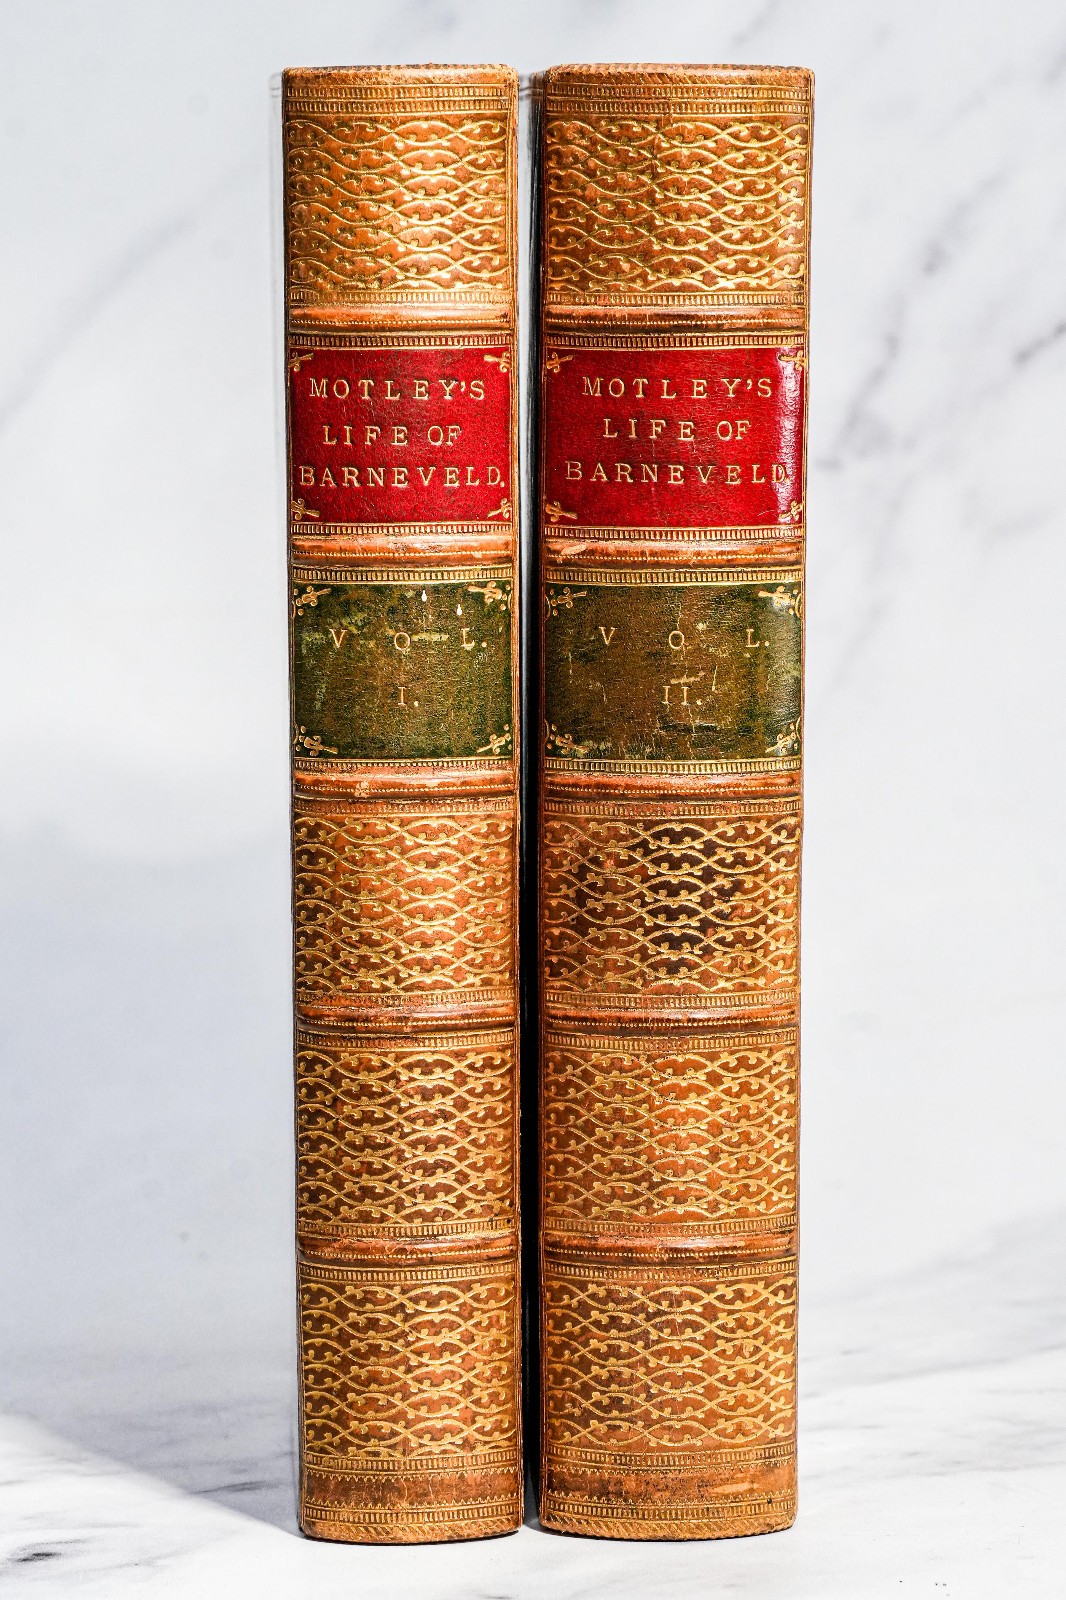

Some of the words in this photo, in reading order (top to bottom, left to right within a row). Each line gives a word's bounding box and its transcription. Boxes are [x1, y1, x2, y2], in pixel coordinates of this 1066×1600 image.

[309, 378, 485, 400] MOTLEY'S
[582, 376, 773, 398] MOTLEY'S
[322, 425, 409, 446] LIFE
[427, 425, 462, 446] OF
[603, 418, 695, 440] LIFE
[716, 420, 751, 440] OF
[299, 466, 505, 488] BARNEVELD.
[329, 627, 487, 650] VOL.
[599, 626, 770, 650] VOL.
[397, 686, 419, 706] I.
[662, 685, 702, 706] II.
